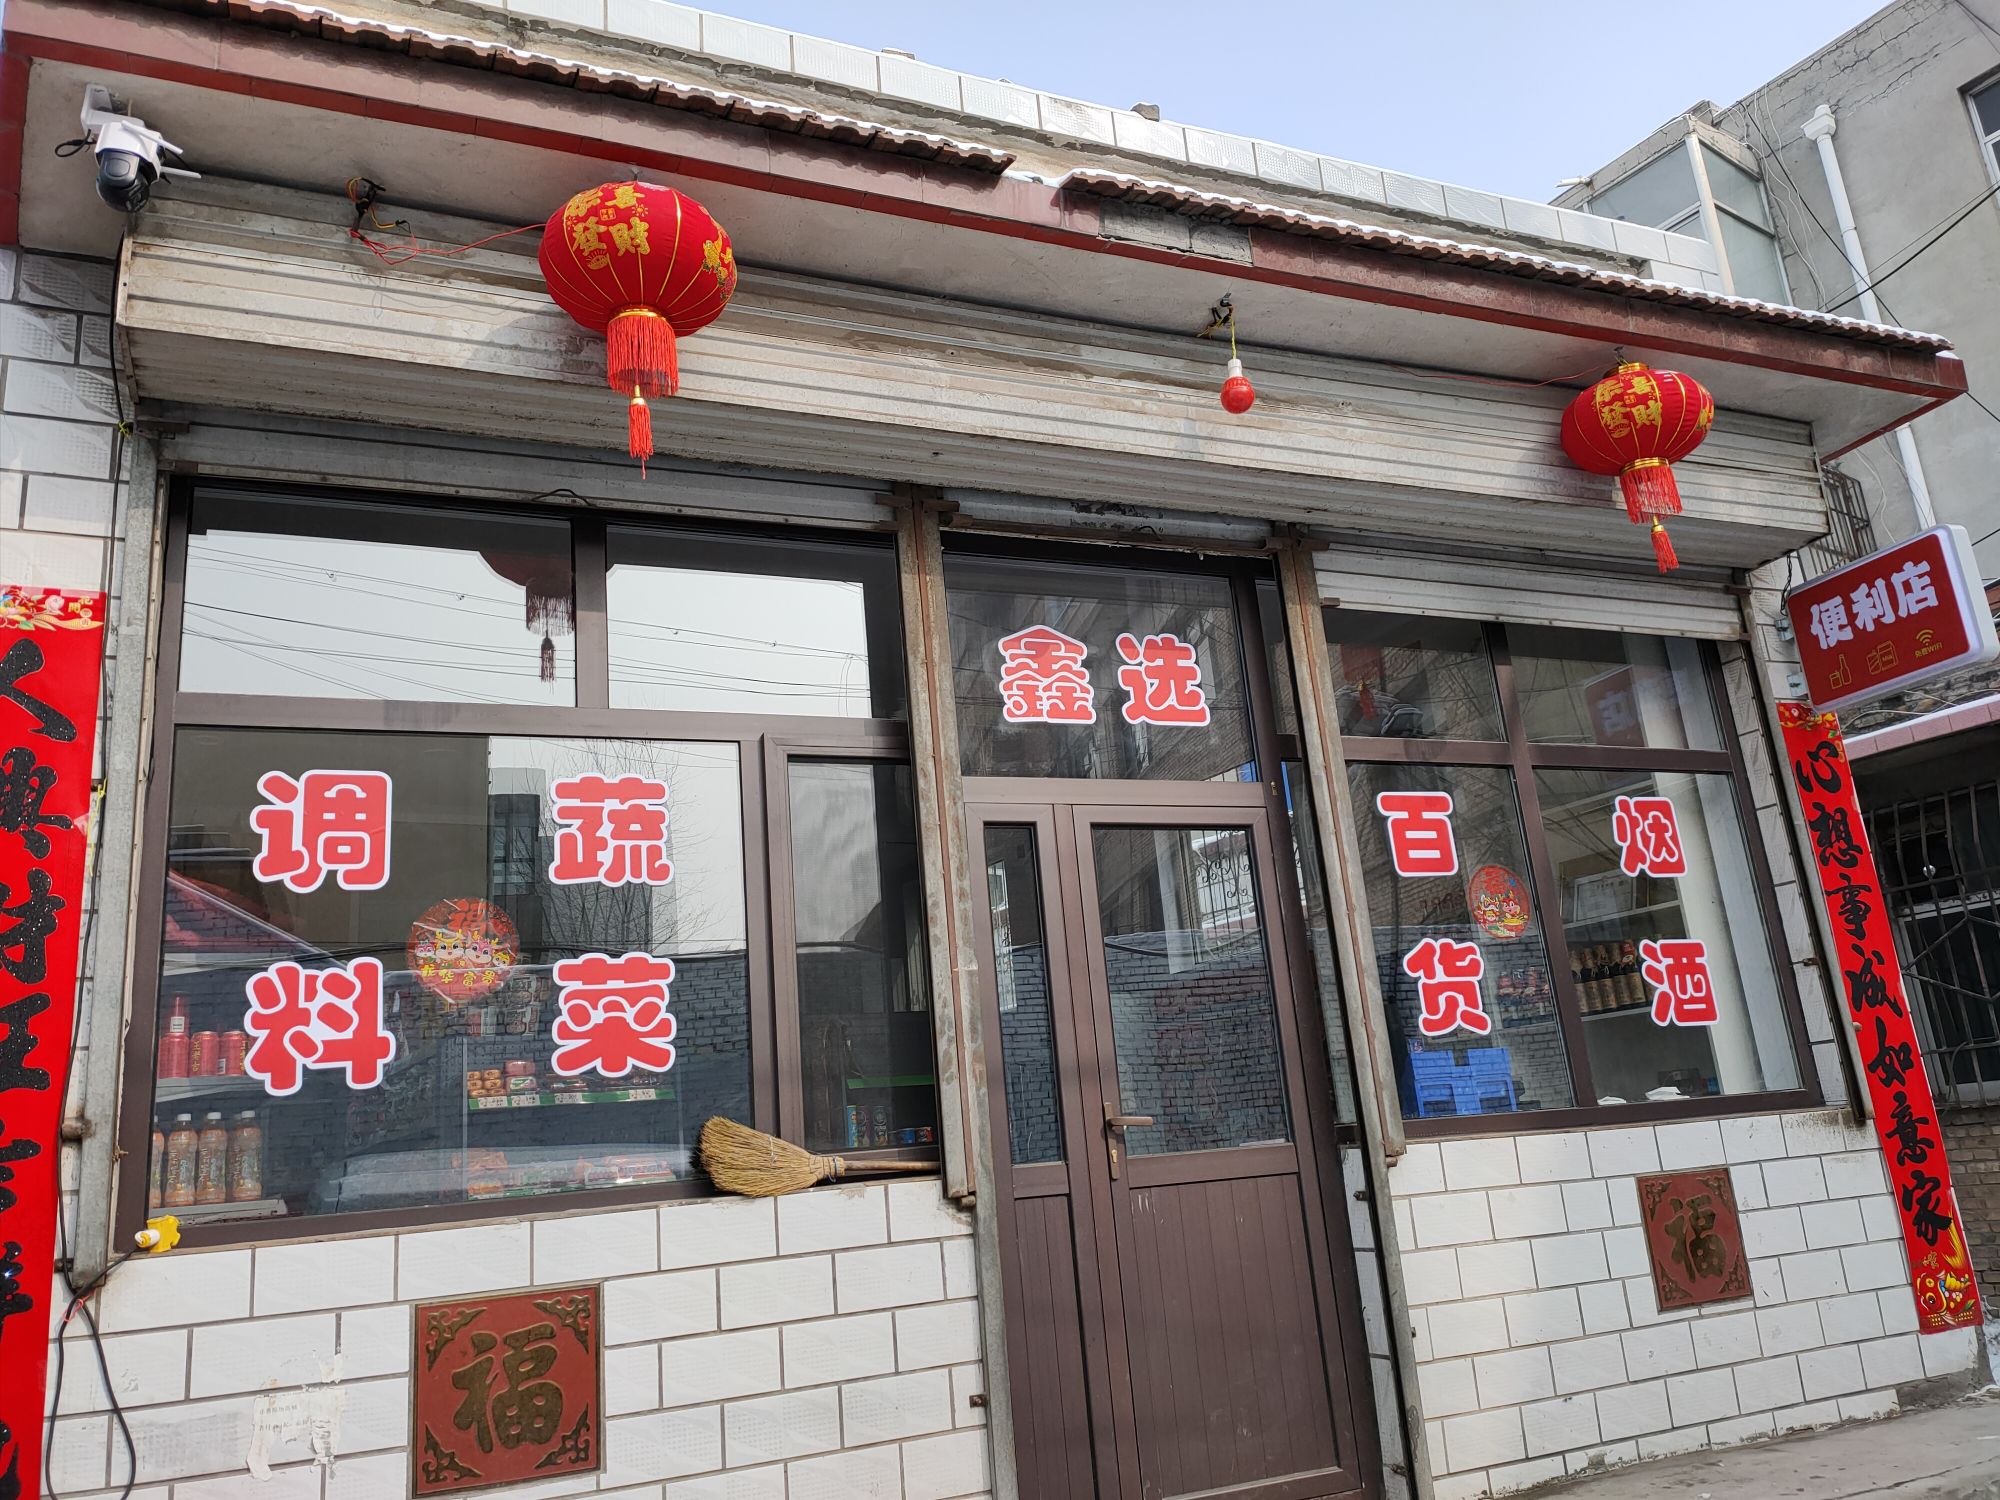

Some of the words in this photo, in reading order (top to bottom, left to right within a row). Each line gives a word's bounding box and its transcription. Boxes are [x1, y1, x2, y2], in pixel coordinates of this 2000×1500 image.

[997, 624, 1211, 727] 鑫选
[1809, 559, 1940, 651] 便利店
[243, 768, 397, 1097] 调料
[548, 772, 678, 1078] 蔬菜
[1376, 790, 1492, 1037] 百货
[1612, 795, 1720, 1027] 烟酒
[1794, 740, 1953, 1247] 心想事成如意家
[1663, 1194, 1727, 1284] 福
[451, 1323, 564, 1454] 福
